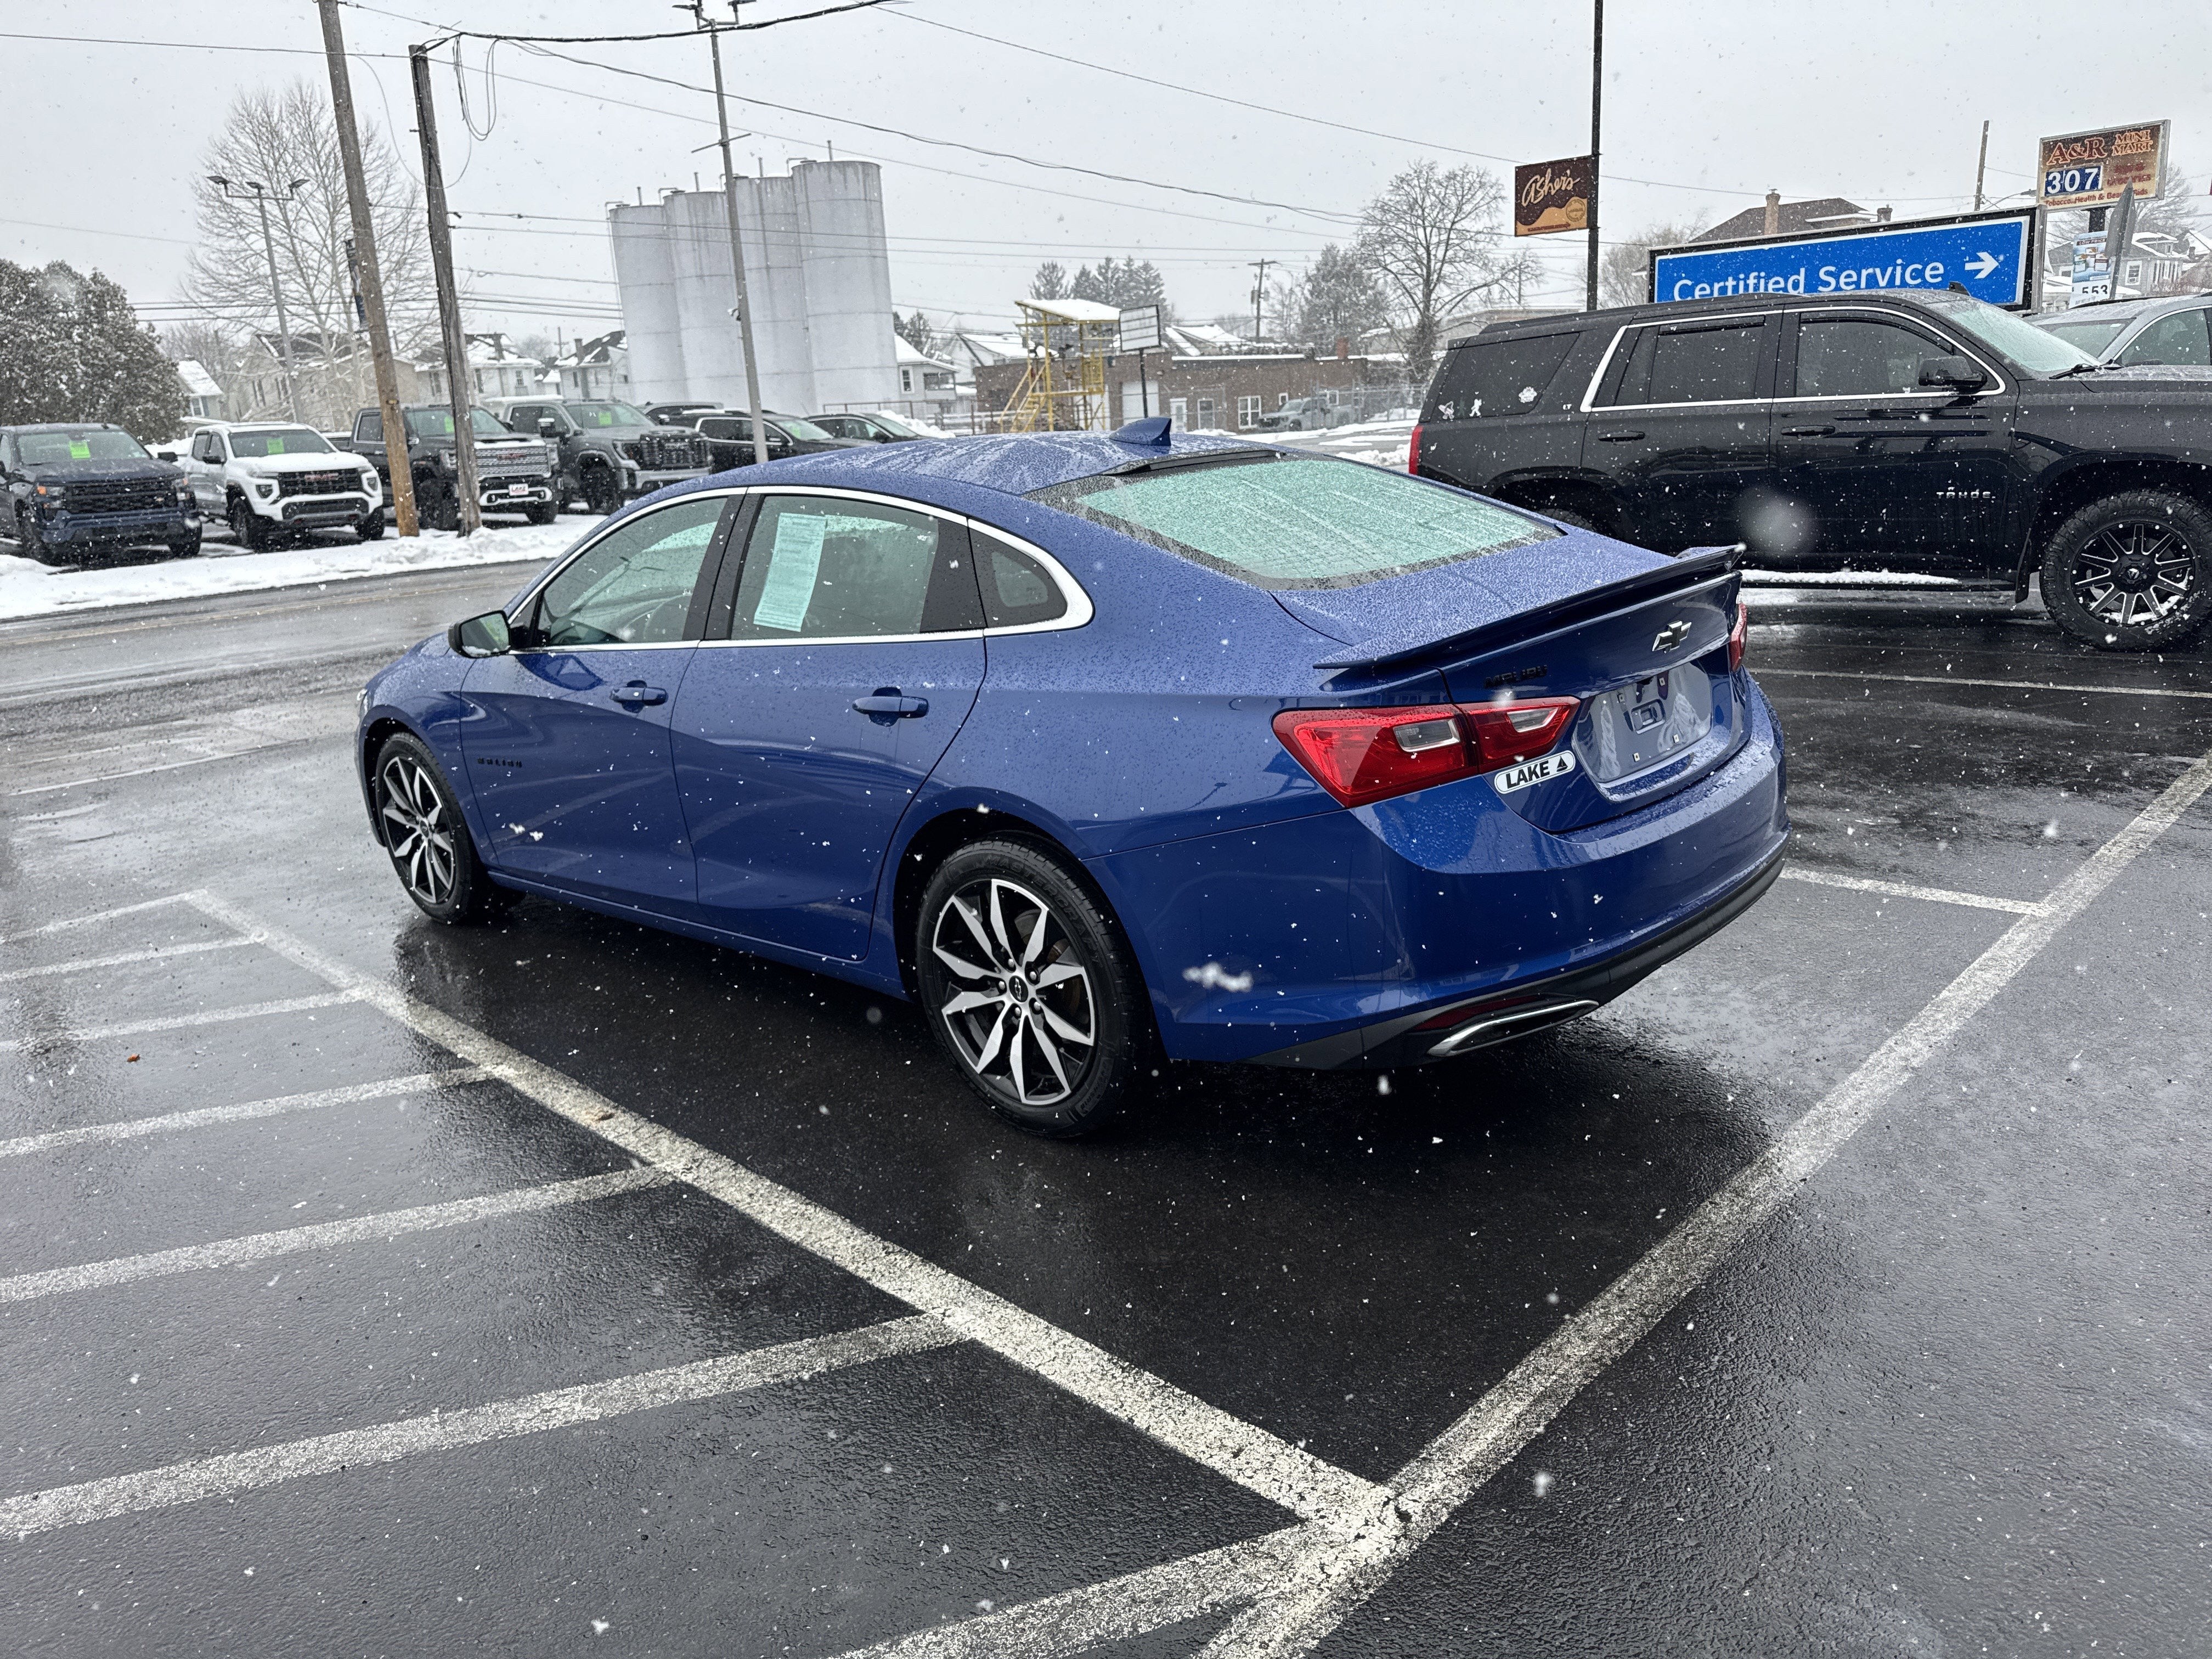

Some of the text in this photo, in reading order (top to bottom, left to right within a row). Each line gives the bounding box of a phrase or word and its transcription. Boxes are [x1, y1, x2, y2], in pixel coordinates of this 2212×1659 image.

[2112, 140, 2154, 156] MART
[2114, 129, 2151, 145] MINI
[2046, 137, 2108, 166] A&R
[1521, 168, 1581, 207] Asher's
[2047, 167, 2099, 194] 307
[1673, 258, 1945, 301] Certified Service
[304, 472, 339, 482] GMC
[1505, 760, 1550, 789] LAKE
